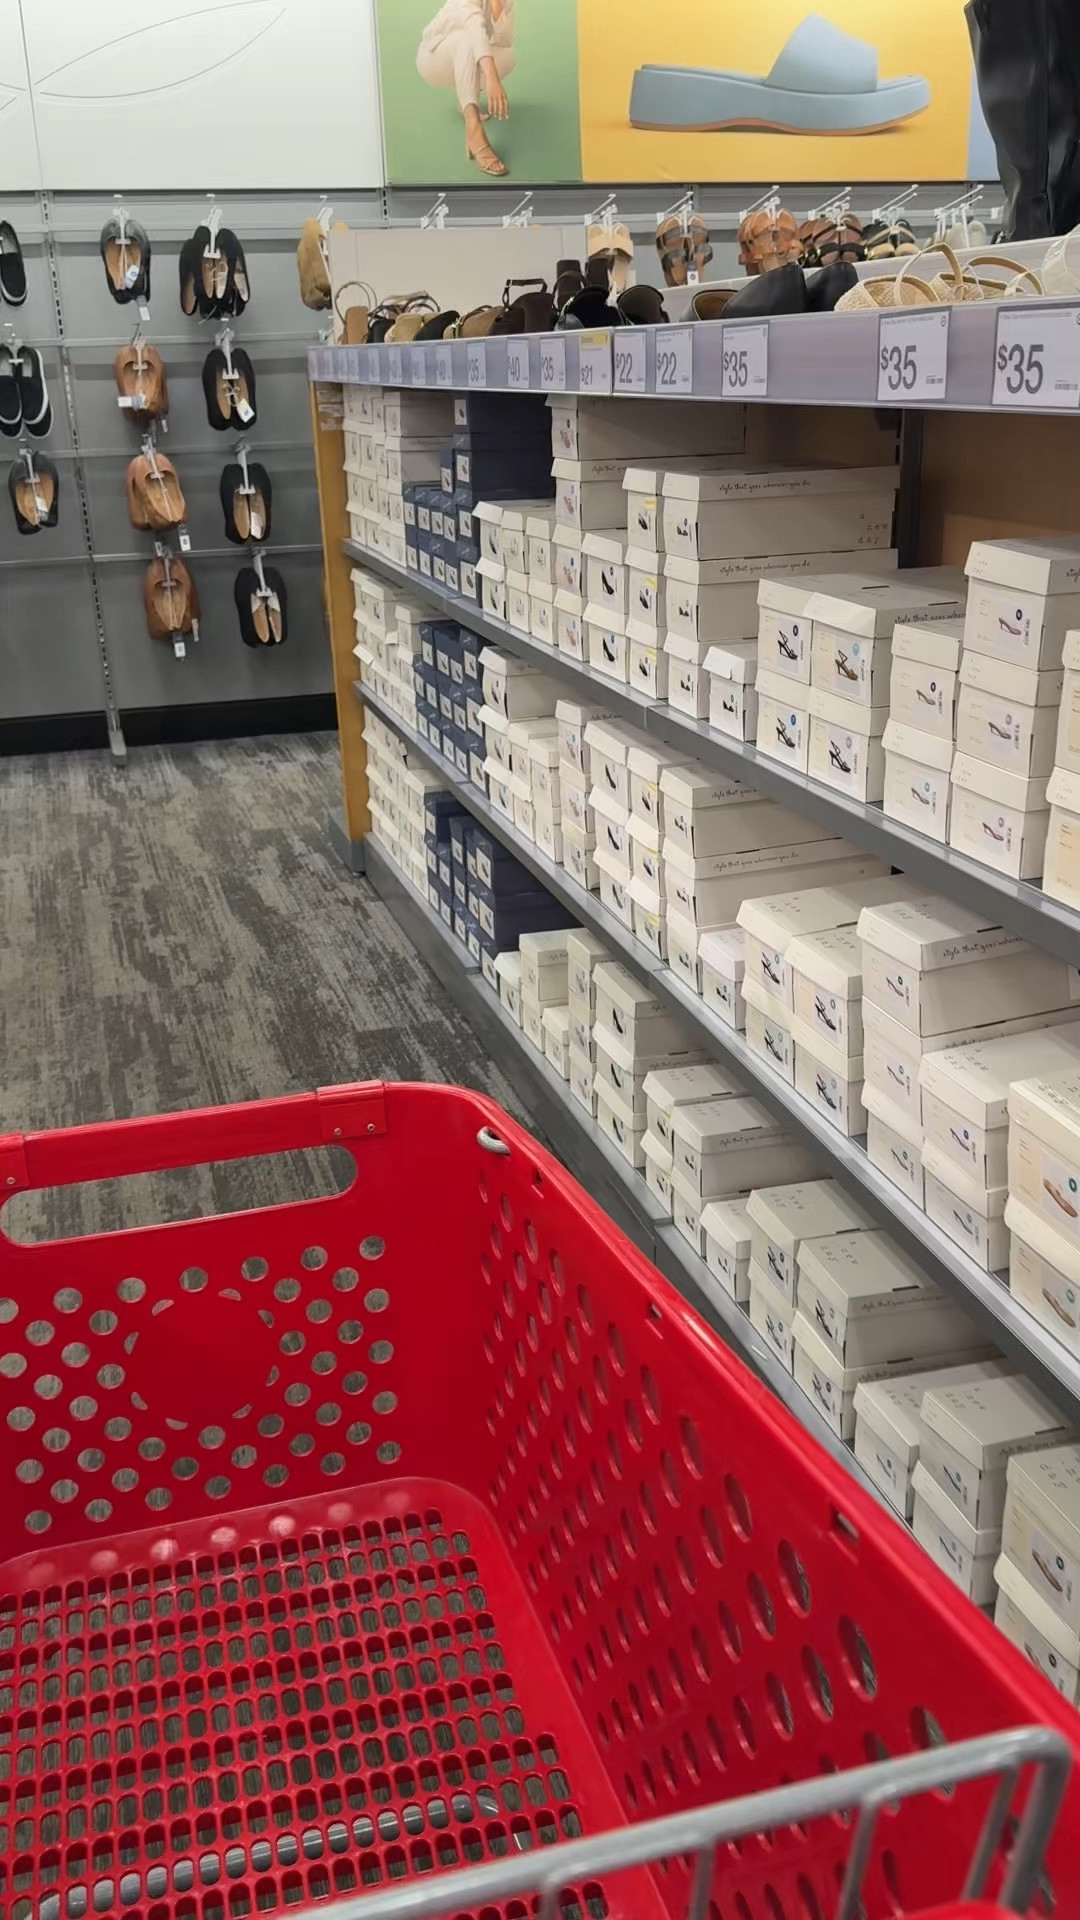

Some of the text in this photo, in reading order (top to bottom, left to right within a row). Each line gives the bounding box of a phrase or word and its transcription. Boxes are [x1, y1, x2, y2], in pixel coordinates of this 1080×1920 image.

[541, 356, 554, 382] $35
[581, 364, 593, 385] $21
[616, 352, 632, 384] $22
[657, 351, 677, 385] $22
[723, 350, 749, 388] $35
[880, 344, 917, 391] $35
[997, 343, 1045, 395] $35
